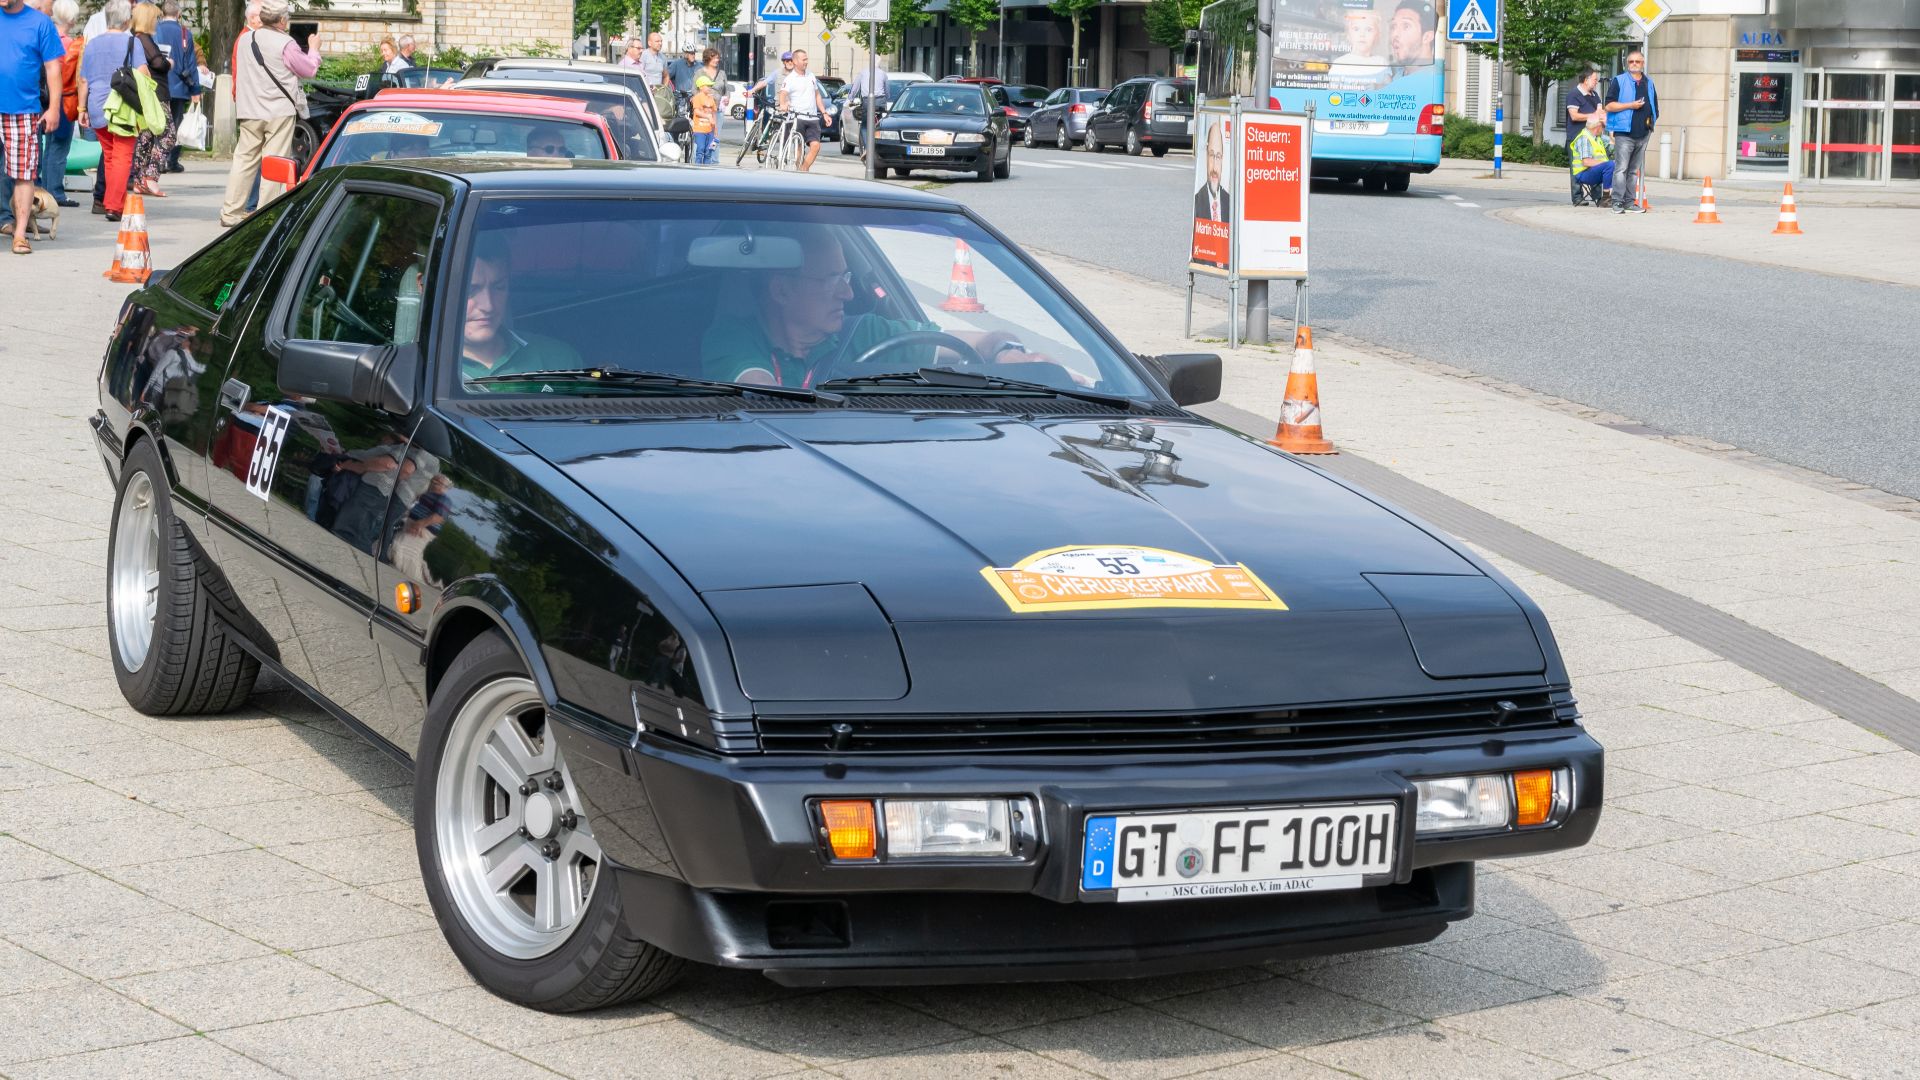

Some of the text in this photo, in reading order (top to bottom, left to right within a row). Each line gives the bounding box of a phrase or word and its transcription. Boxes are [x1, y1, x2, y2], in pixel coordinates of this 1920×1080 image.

[1279, 42, 1303, 50] MEINE
[1741, 31, 1784, 45] ALRA
[356, 75, 369, 89] 60
[387, 115, 401, 124] 56
[1247, 126, 1291, 144] Steuern:
[1247, 146, 1285, 162] mit uns
[1246, 166, 1299, 184] gerechter!
[1195, 220, 1229, 239] Martin Schulz
[249, 408, 288, 494] 55
[1096, 556, 1141, 575] 55
[1041, 571, 1224, 596] CHERUSKERFAHRT
[1118, 813, 1390, 879] GT FF 100H
[1092, 860, 1105, 876] D
[1172, 879, 1314, 896] MSC Gütersloh e.V. im ADAC
